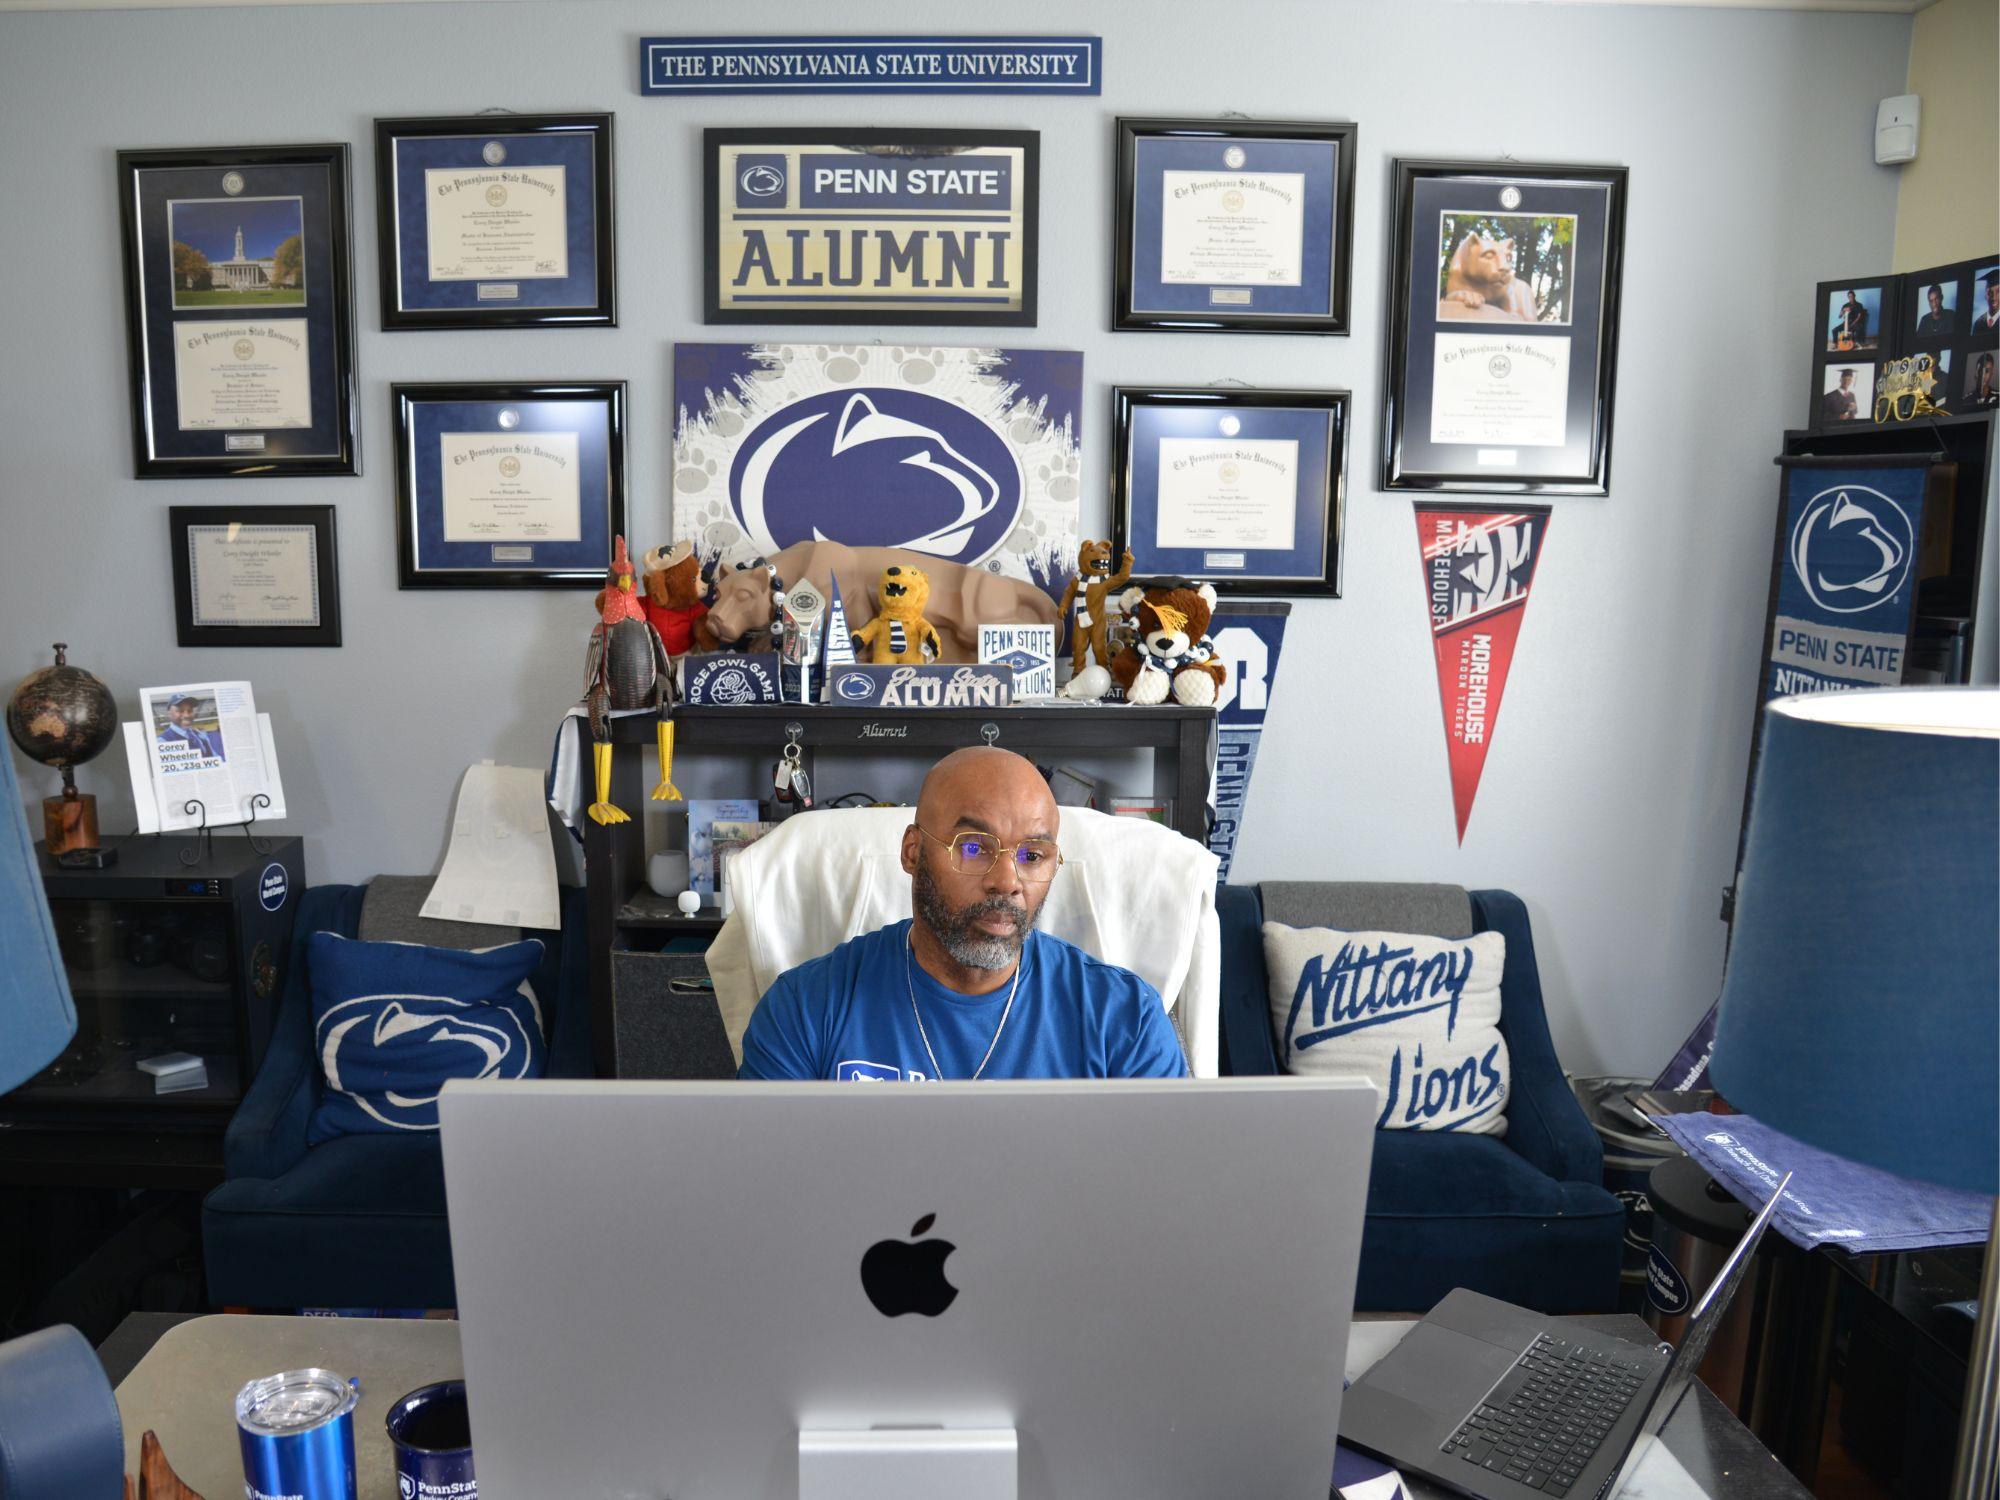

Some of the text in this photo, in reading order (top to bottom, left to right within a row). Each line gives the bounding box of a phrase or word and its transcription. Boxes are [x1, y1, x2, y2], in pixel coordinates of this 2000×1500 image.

[661, 53, 1078, 77] THE PENNSYLVANIA STATE UNIVERSITY
[438, 184, 452, 196] The
[501, 172, 519, 184] State
[815, 168, 999, 195] PENN STATE
[1174, 187, 1189, 199] The
[1239, 178, 1257, 189] State
[732, 229, 1011, 288] ALUMNI
[1431, 520, 1452, 625] MOREHOUSE
[984, 631, 1051, 658] PENN STATE
[1779, 630, 1900, 672] PENN STATE
[690, 669, 710, 704] ROSE
[708, 658, 748, 672] BOWL
[749, 663, 775, 701] GAME
[889, 666, 942, 687] Penn
[950, 666, 1000, 687] State
[1025, 667, 1051, 694] LIONS
[1454, 640, 1470, 738] MAROON TIGERS
[1464, 633, 1492, 745] MOREHOUSE
[880, 683, 1008, 706] ALUMNI
[857, 724, 908, 739] Alumni
[158, 744, 185, 752] Corey
[160, 752, 198, 761] Wheeler
[203, 759, 219, 767] WC
[1285, 940, 1473, 1066] Nittany
[1376, 1043, 1500, 1130] Lions
[418, 1480, 477, 1494] PennStat
